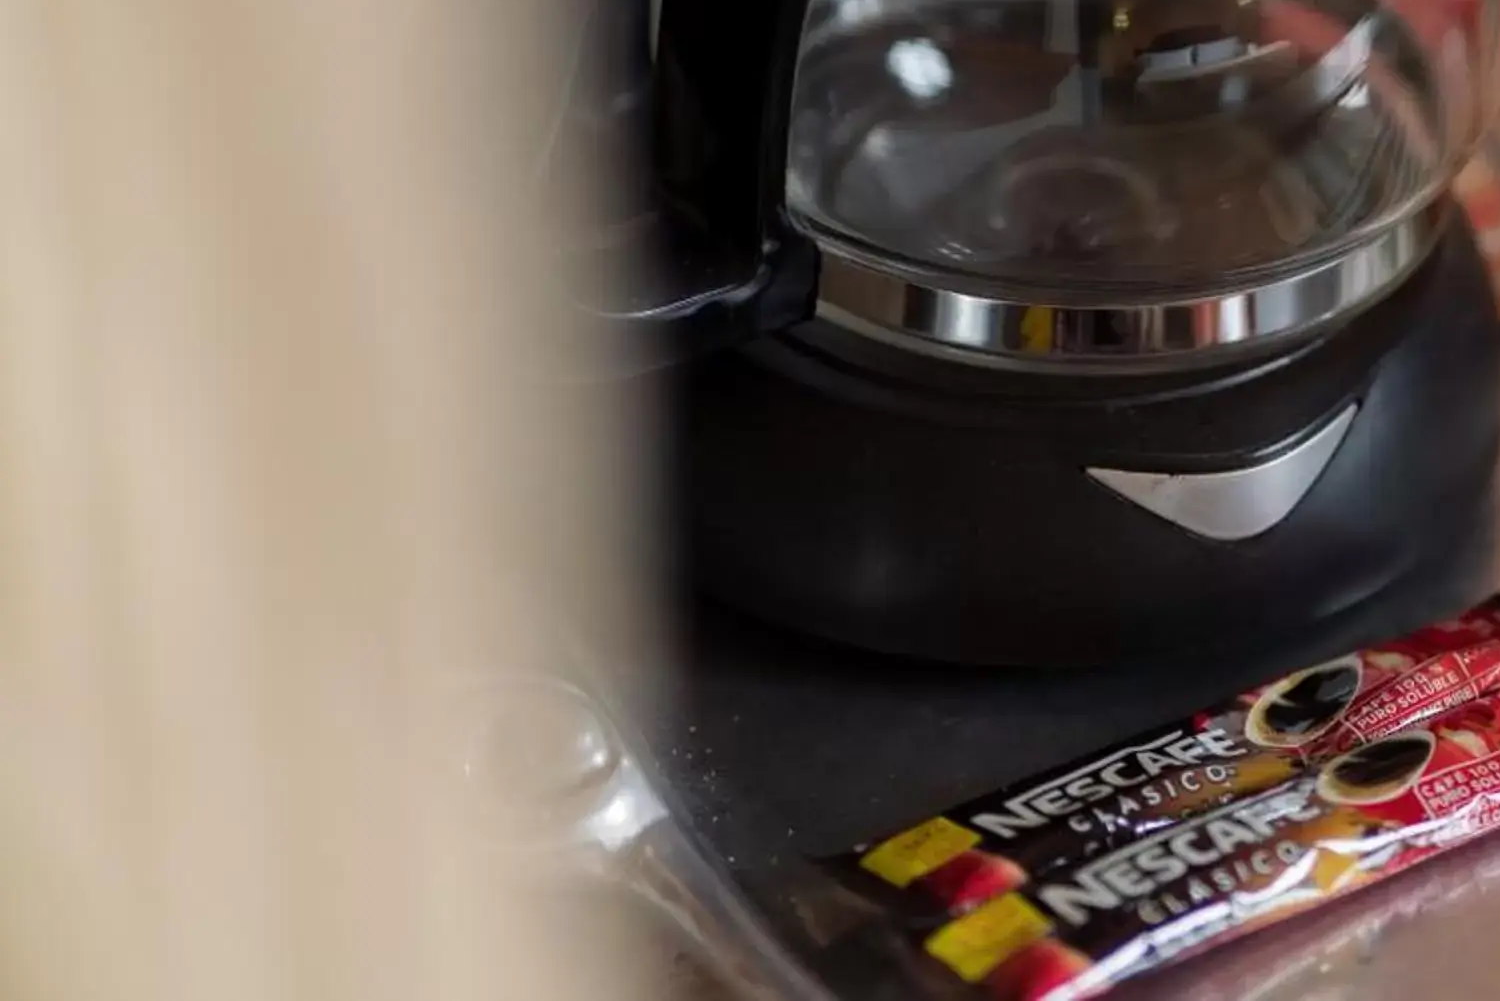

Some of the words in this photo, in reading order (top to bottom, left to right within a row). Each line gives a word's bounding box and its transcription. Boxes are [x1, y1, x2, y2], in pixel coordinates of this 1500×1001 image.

[1356, 703, 1397, 730] PURO
[1397, 671, 1459, 708] SOLUBLE
[1468, 760, 1500, 778] 100
[1427, 785, 1471, 812] PURO
